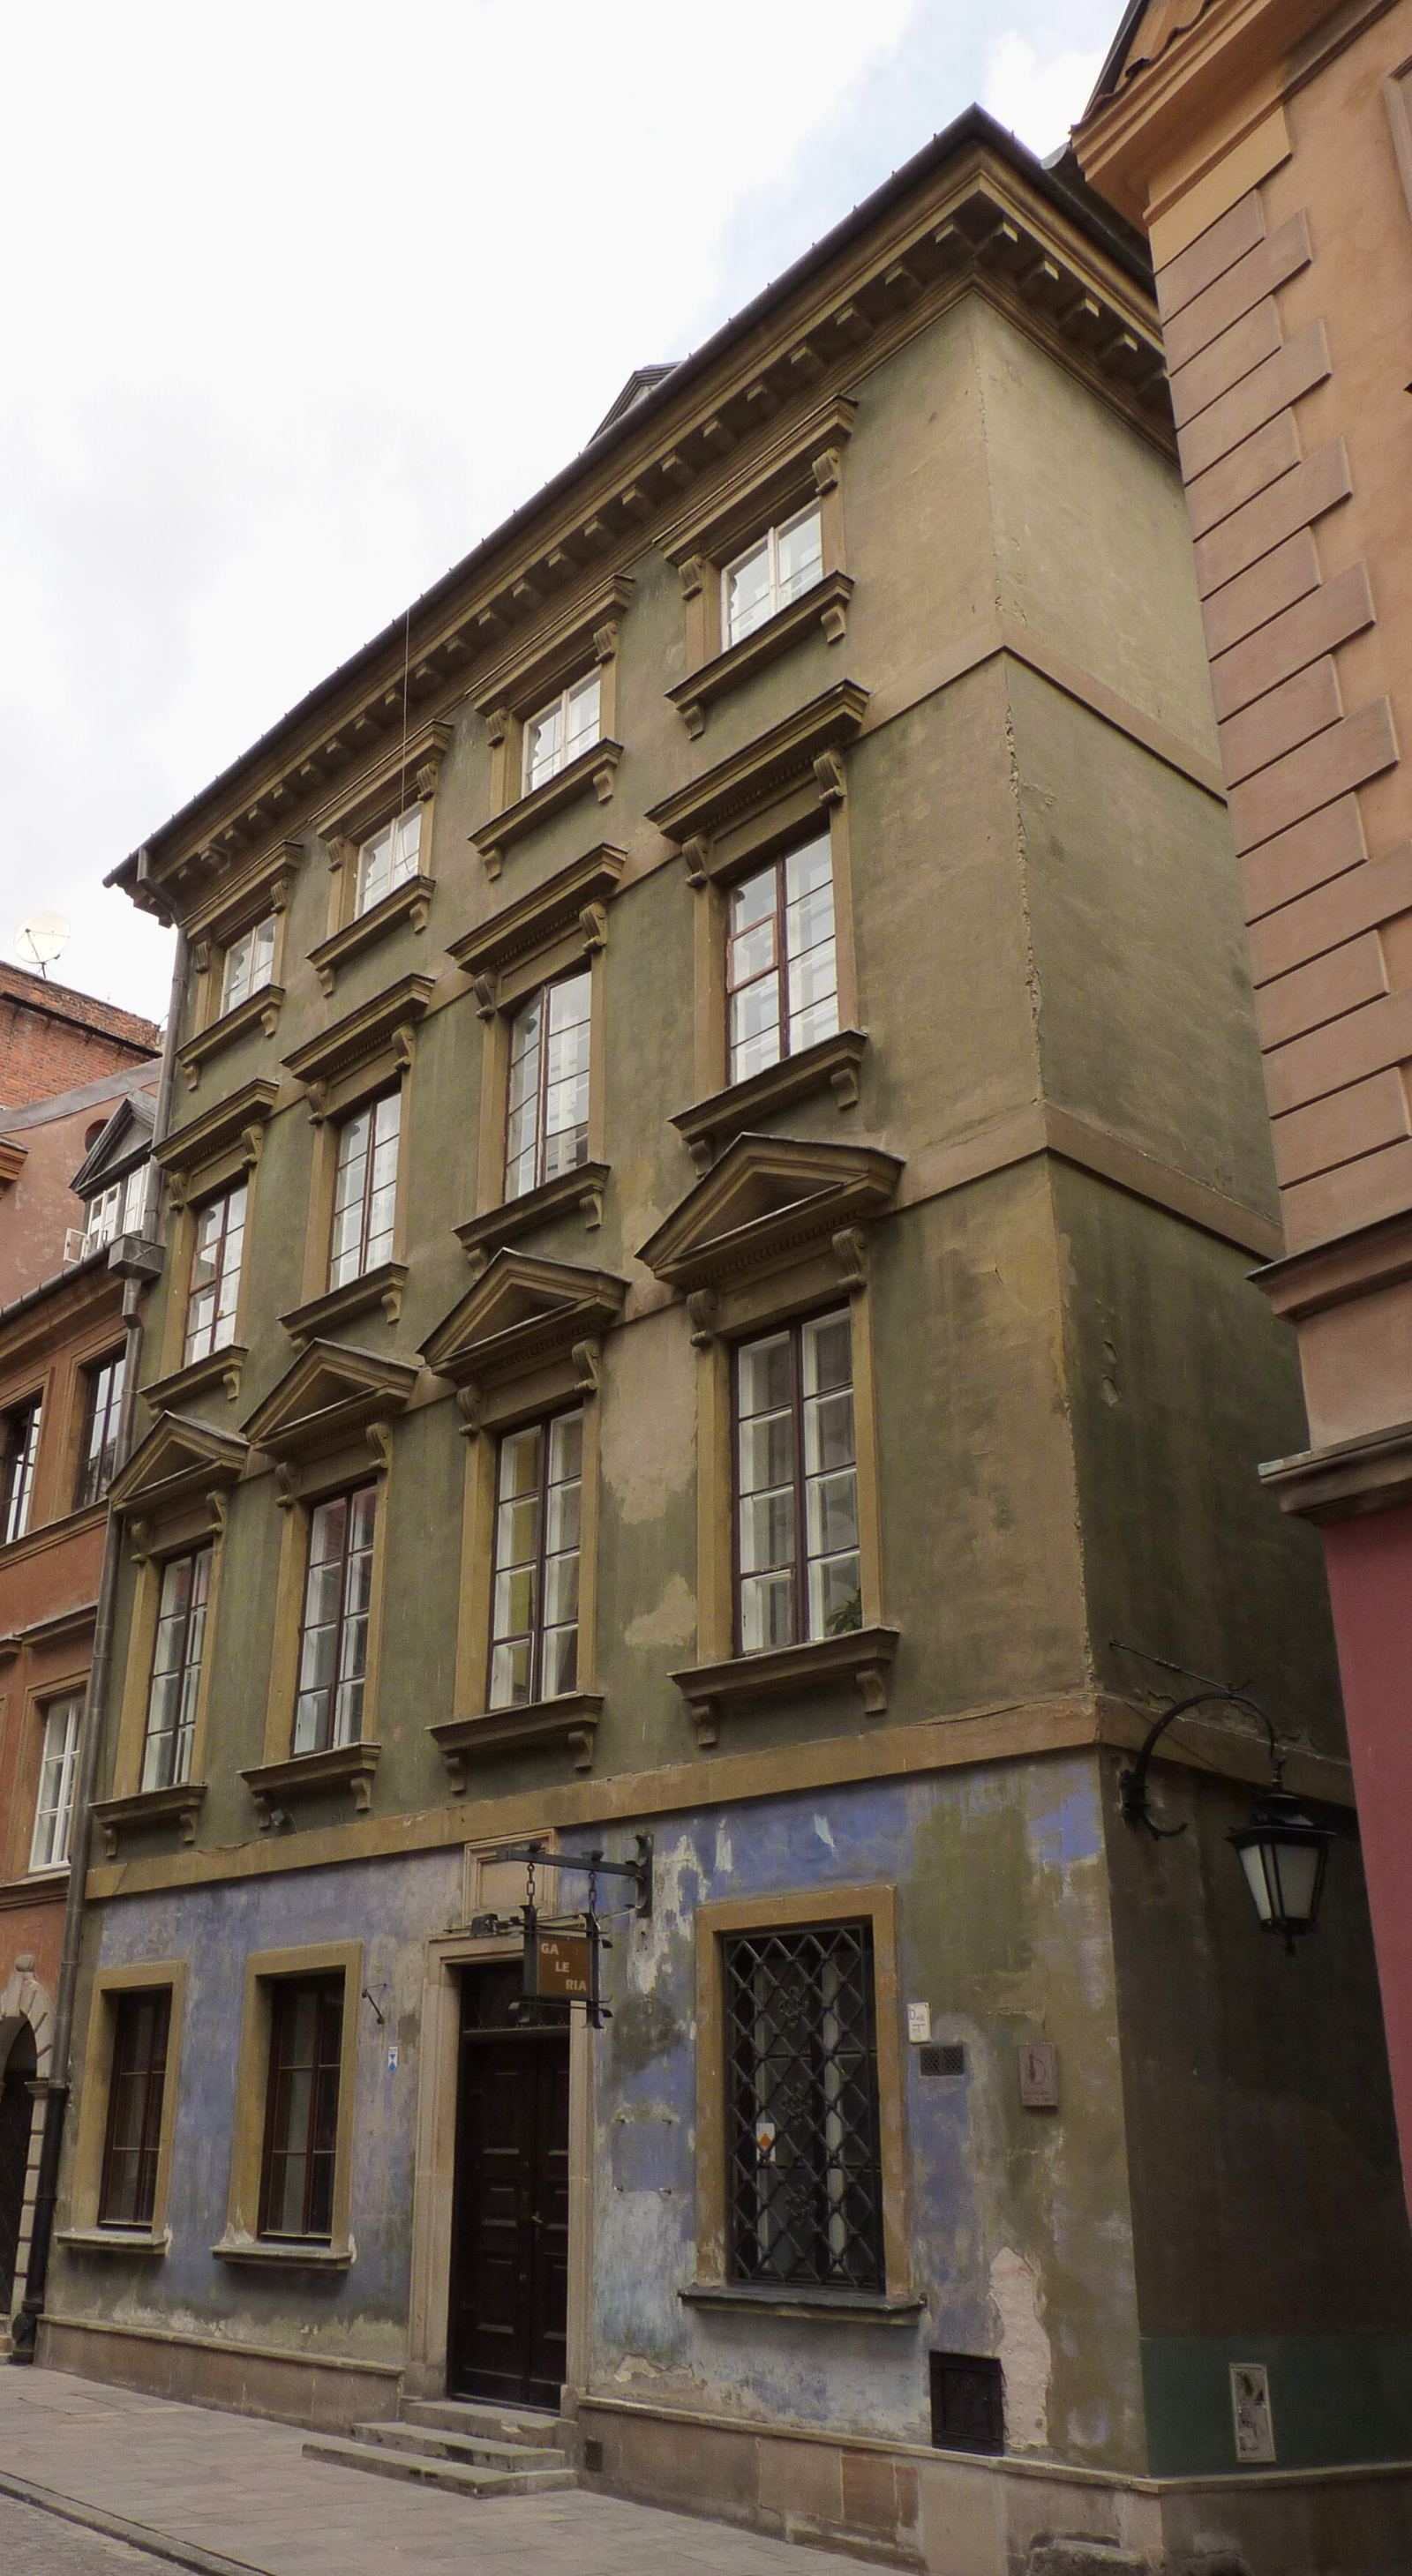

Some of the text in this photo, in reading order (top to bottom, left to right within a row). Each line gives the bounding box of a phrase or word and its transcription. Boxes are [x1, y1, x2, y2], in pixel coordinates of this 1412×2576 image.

[540, 1943, 560, 1955] GA
[555, 1960, 570, 1973] LE
[565, 1979, 587, 1991] RIA
